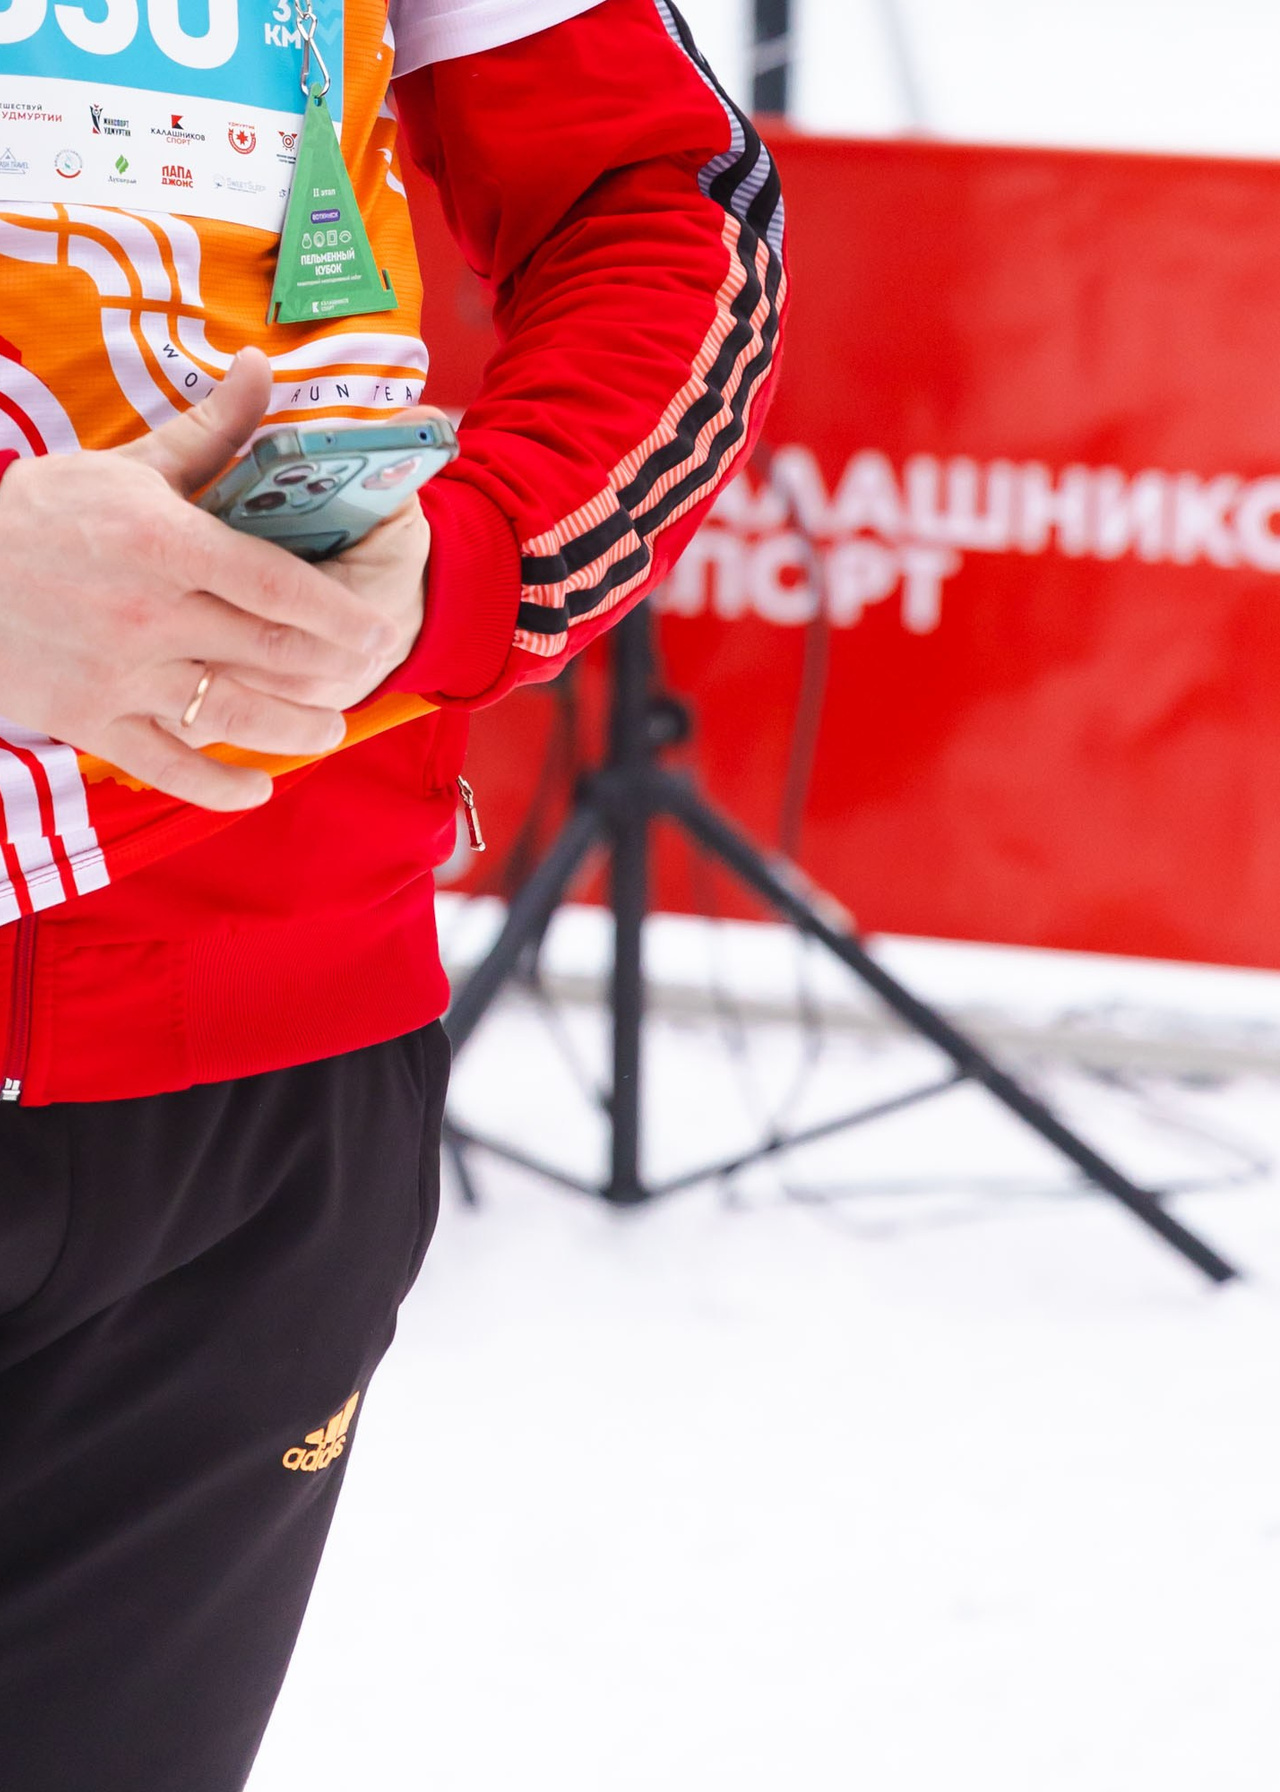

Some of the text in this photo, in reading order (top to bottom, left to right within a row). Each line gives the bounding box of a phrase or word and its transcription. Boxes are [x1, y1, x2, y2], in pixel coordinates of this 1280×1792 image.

[264, 23, 302, 49] КМ
[2, 111, 63, 123] УДМУРТИИ
[150, 128, 206, 141] КАЛАШНИКОВ
[166, 137, 191, 145] СПОРТ
[162, 165, 193, 180] ПАПА
[161, 177, 194, 189] ДЖОНС
[301, 247, 355, 266] ПЕЛЬМЕННЫЙ
[315, 263, 342, 276] КУБОК
[290, 383, 424, 403] RUN TEA
[660, 528, 962, 638] ПОРТ
